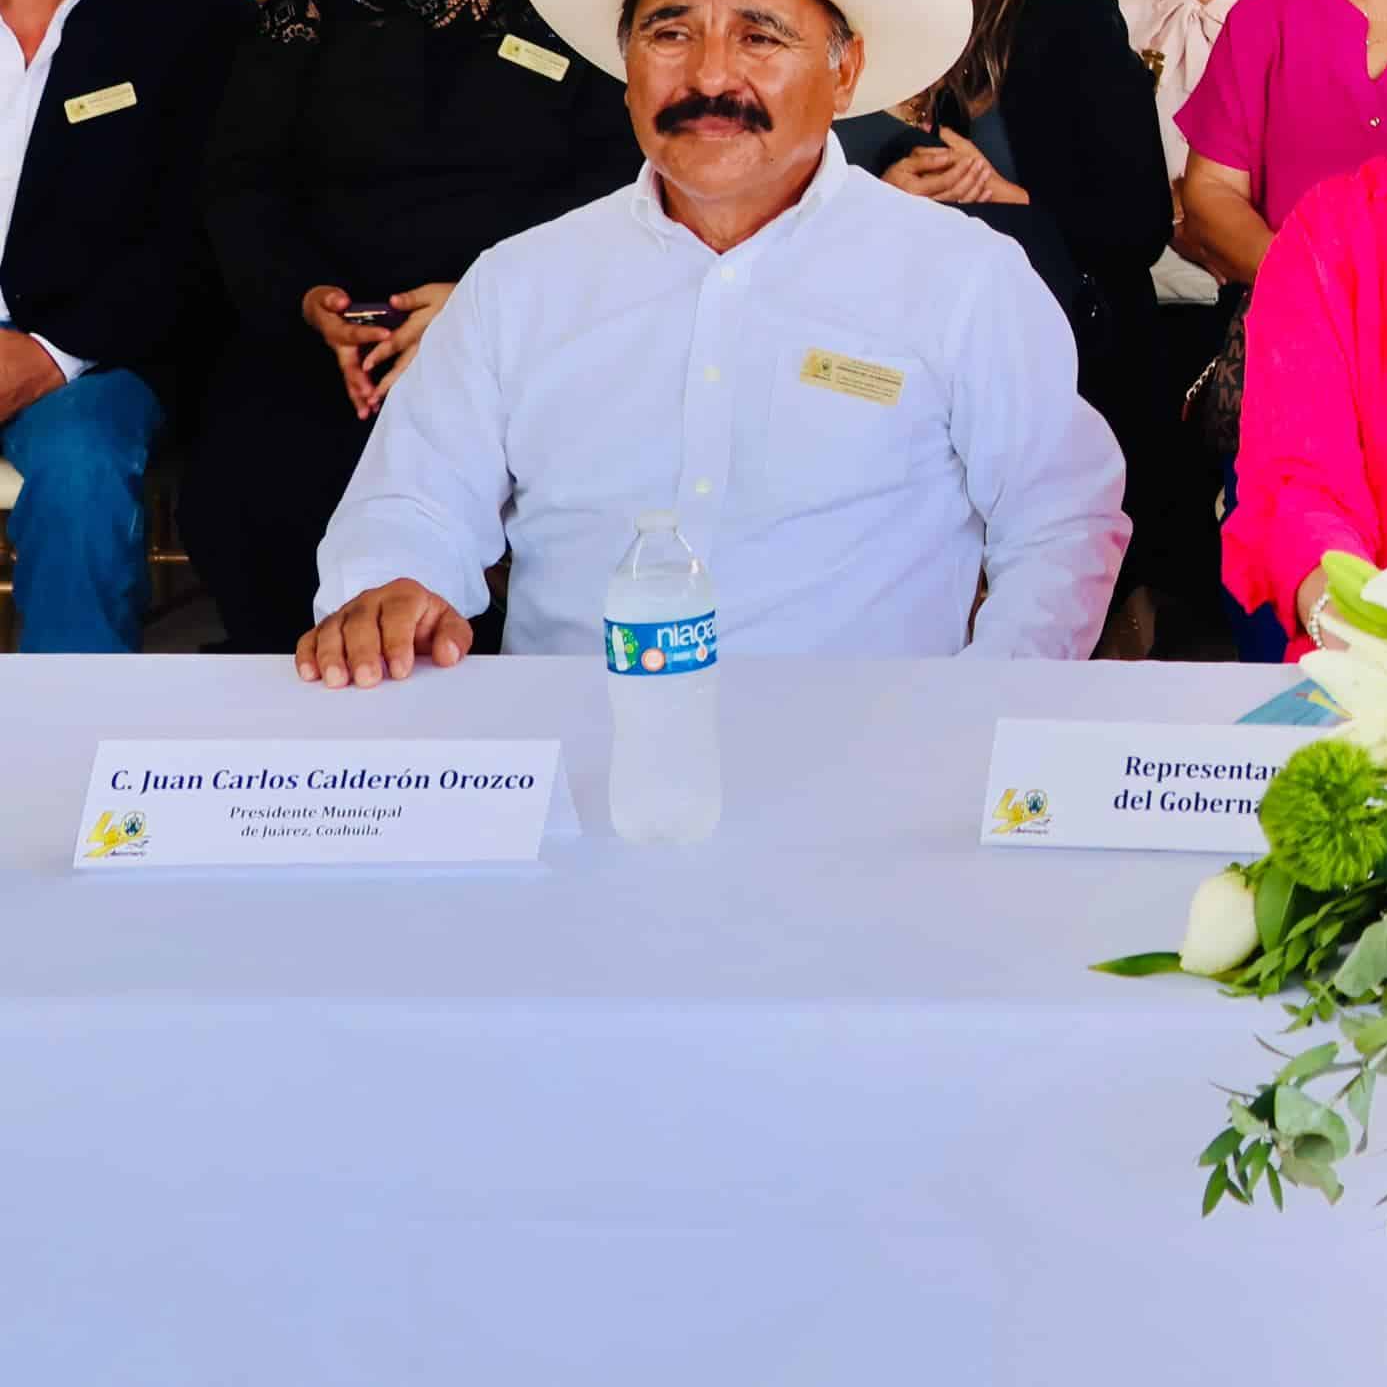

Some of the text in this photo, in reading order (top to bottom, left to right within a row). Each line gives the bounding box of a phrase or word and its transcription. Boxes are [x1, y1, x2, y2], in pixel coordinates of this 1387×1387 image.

[111, 768, 535, 795] C. Juan Carlos Calderón Orozco
[1113, 789, 1152, 811] del
[230, 806, 402, 821] Presidente Municipal
[241, 825, 259, 838] de
